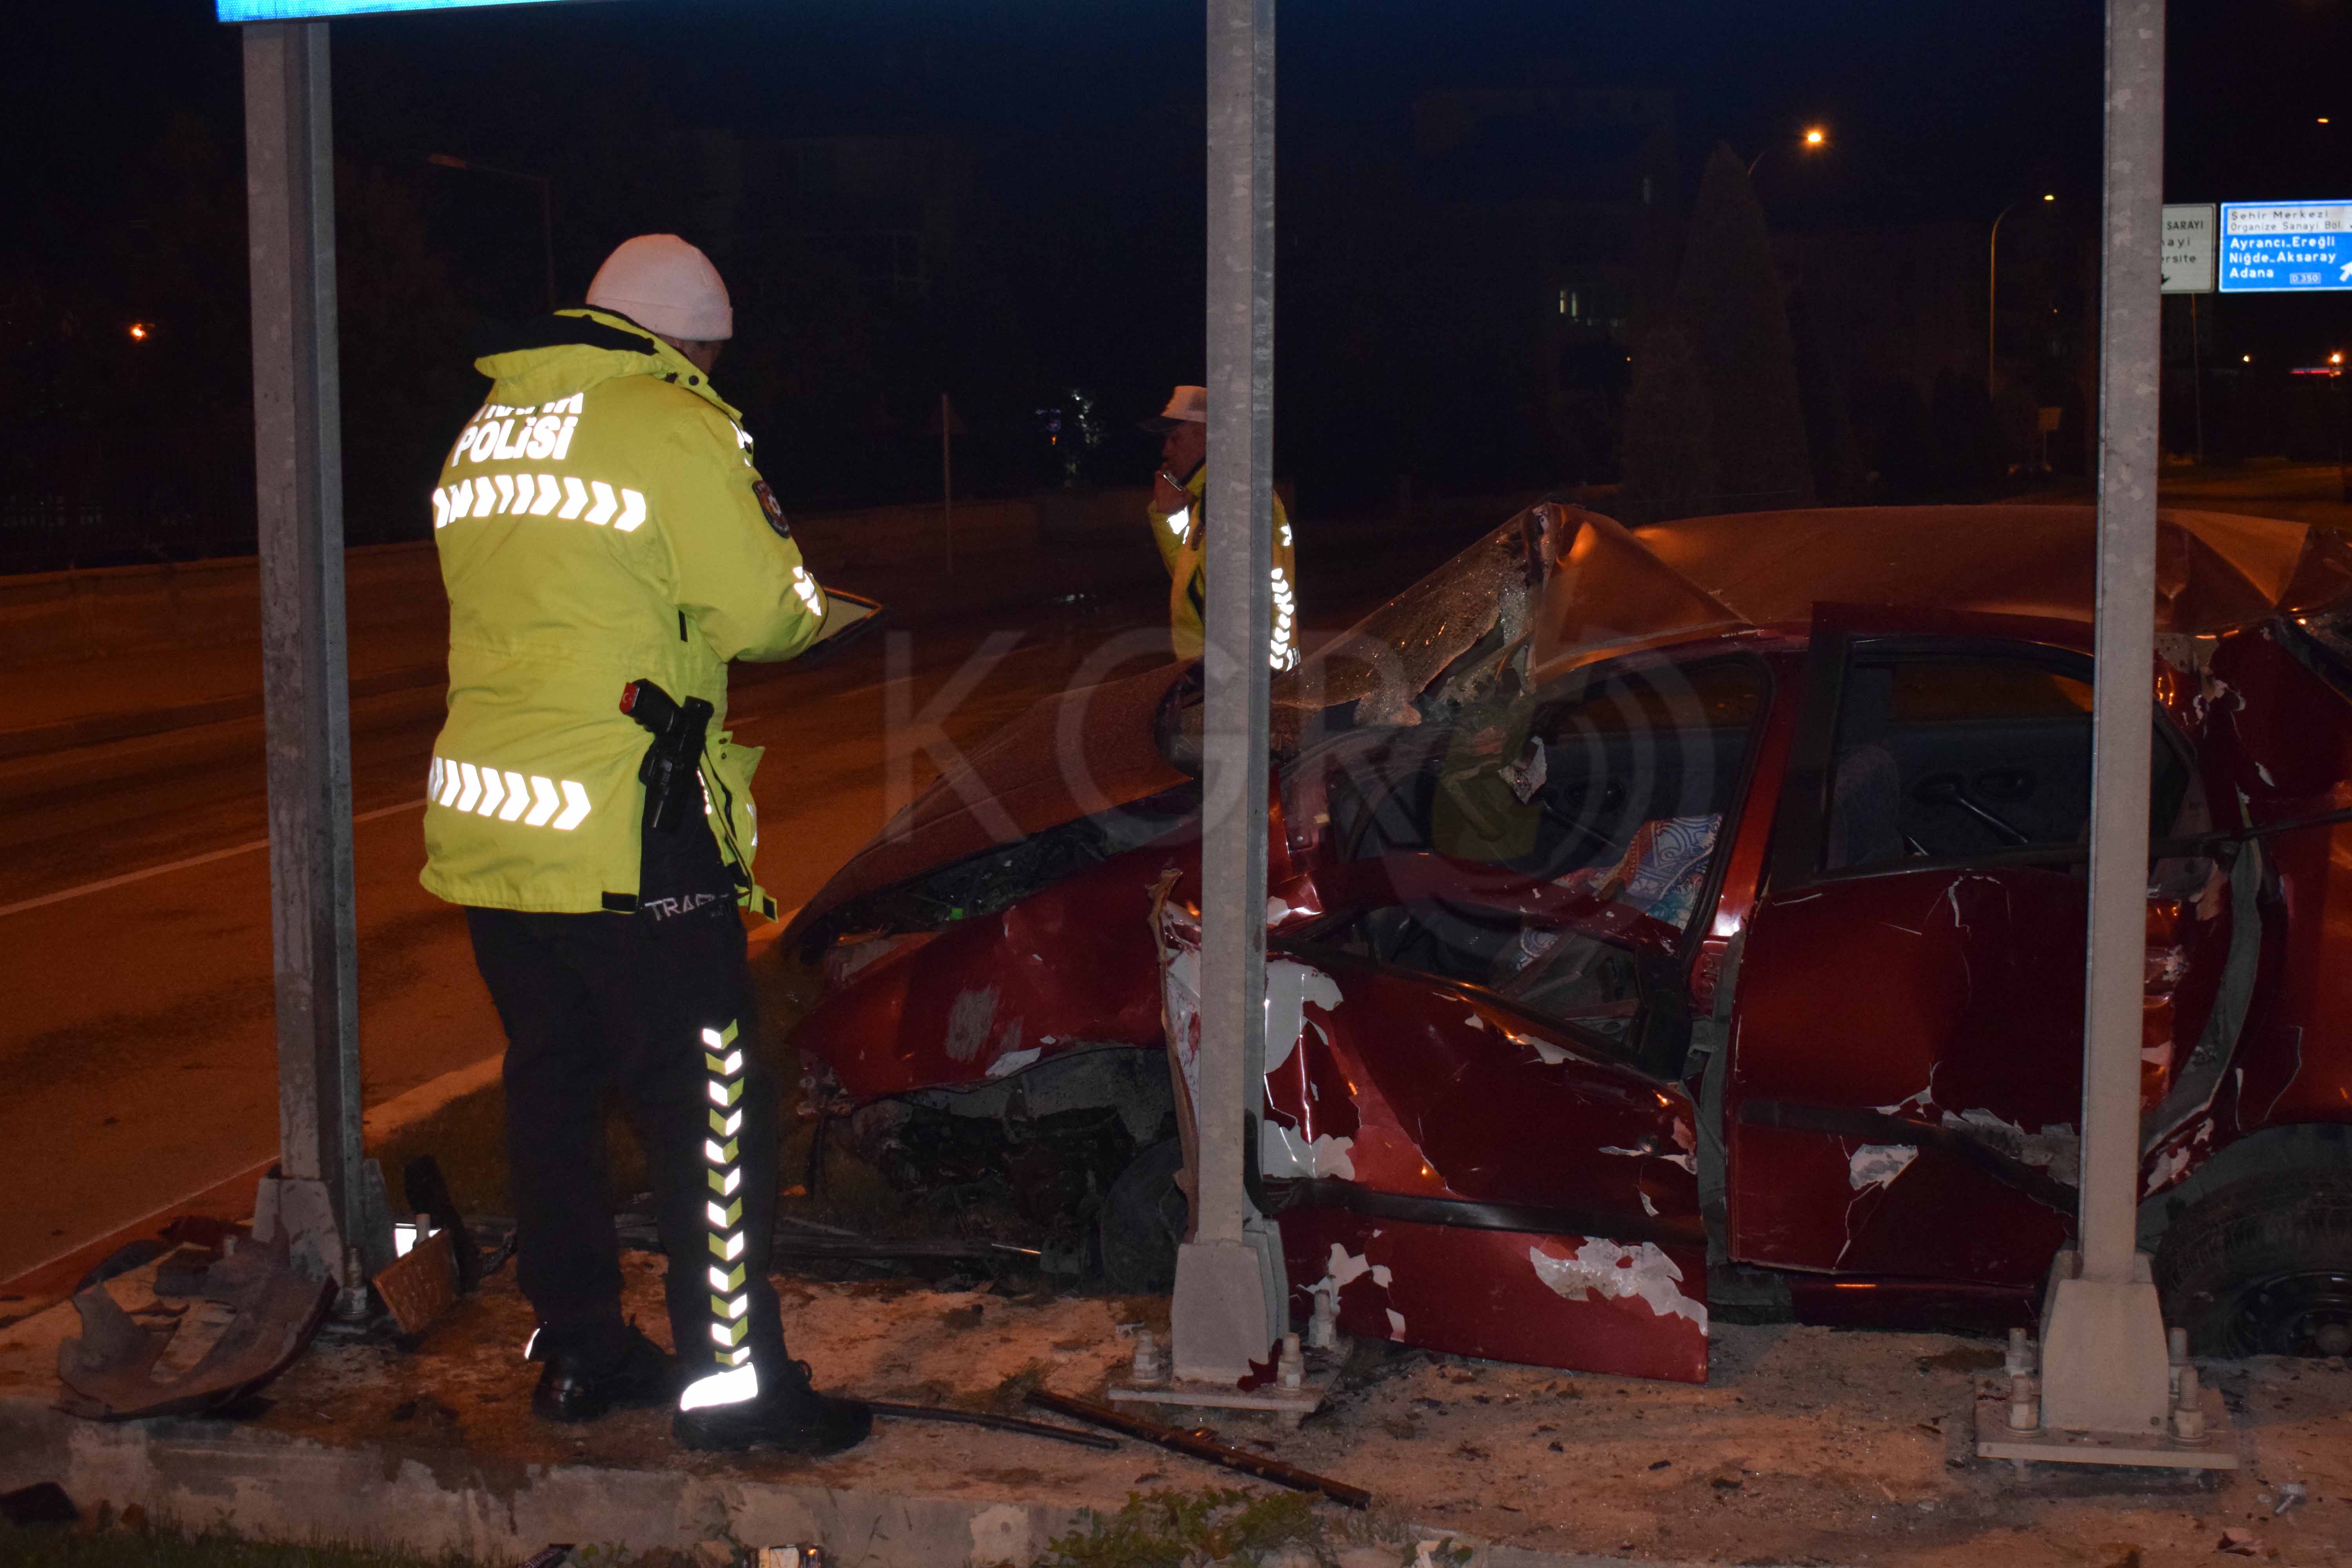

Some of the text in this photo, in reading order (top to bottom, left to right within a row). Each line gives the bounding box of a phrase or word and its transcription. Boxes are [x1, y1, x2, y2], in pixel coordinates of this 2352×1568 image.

[2231, 210, 2328, 220] Şehir Merkezi
[2167, 220, 2203, 230] SARAYI
[2230, 222, 2277, 232] Organize
[2283, 221, 2319, 232] Sanayi
[2229, 267, 2274, 278] Adana
